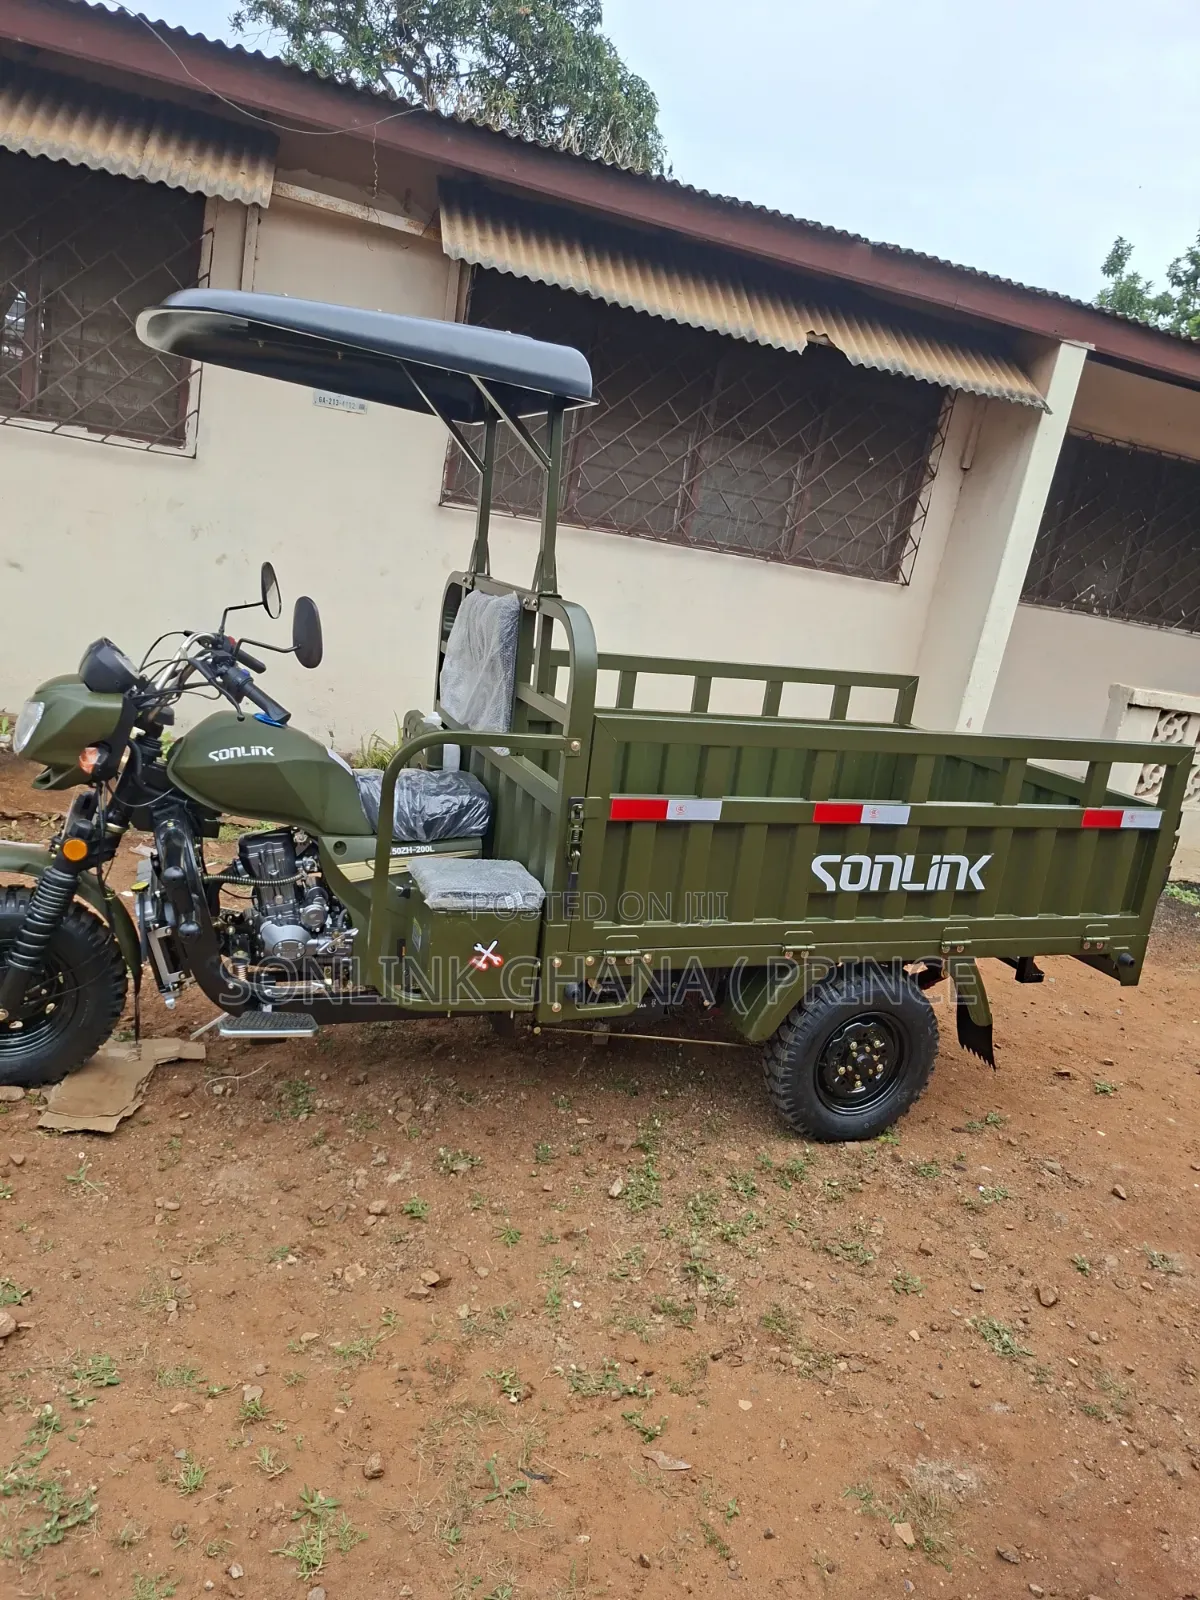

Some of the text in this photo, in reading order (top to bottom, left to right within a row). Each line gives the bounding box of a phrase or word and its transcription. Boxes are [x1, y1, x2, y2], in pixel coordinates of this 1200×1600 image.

[208, 745, 275, 762] SONLINK
[390, 846, 435, 855] 50ZH-200L
[811, 854, 993, 892] SONLINK
